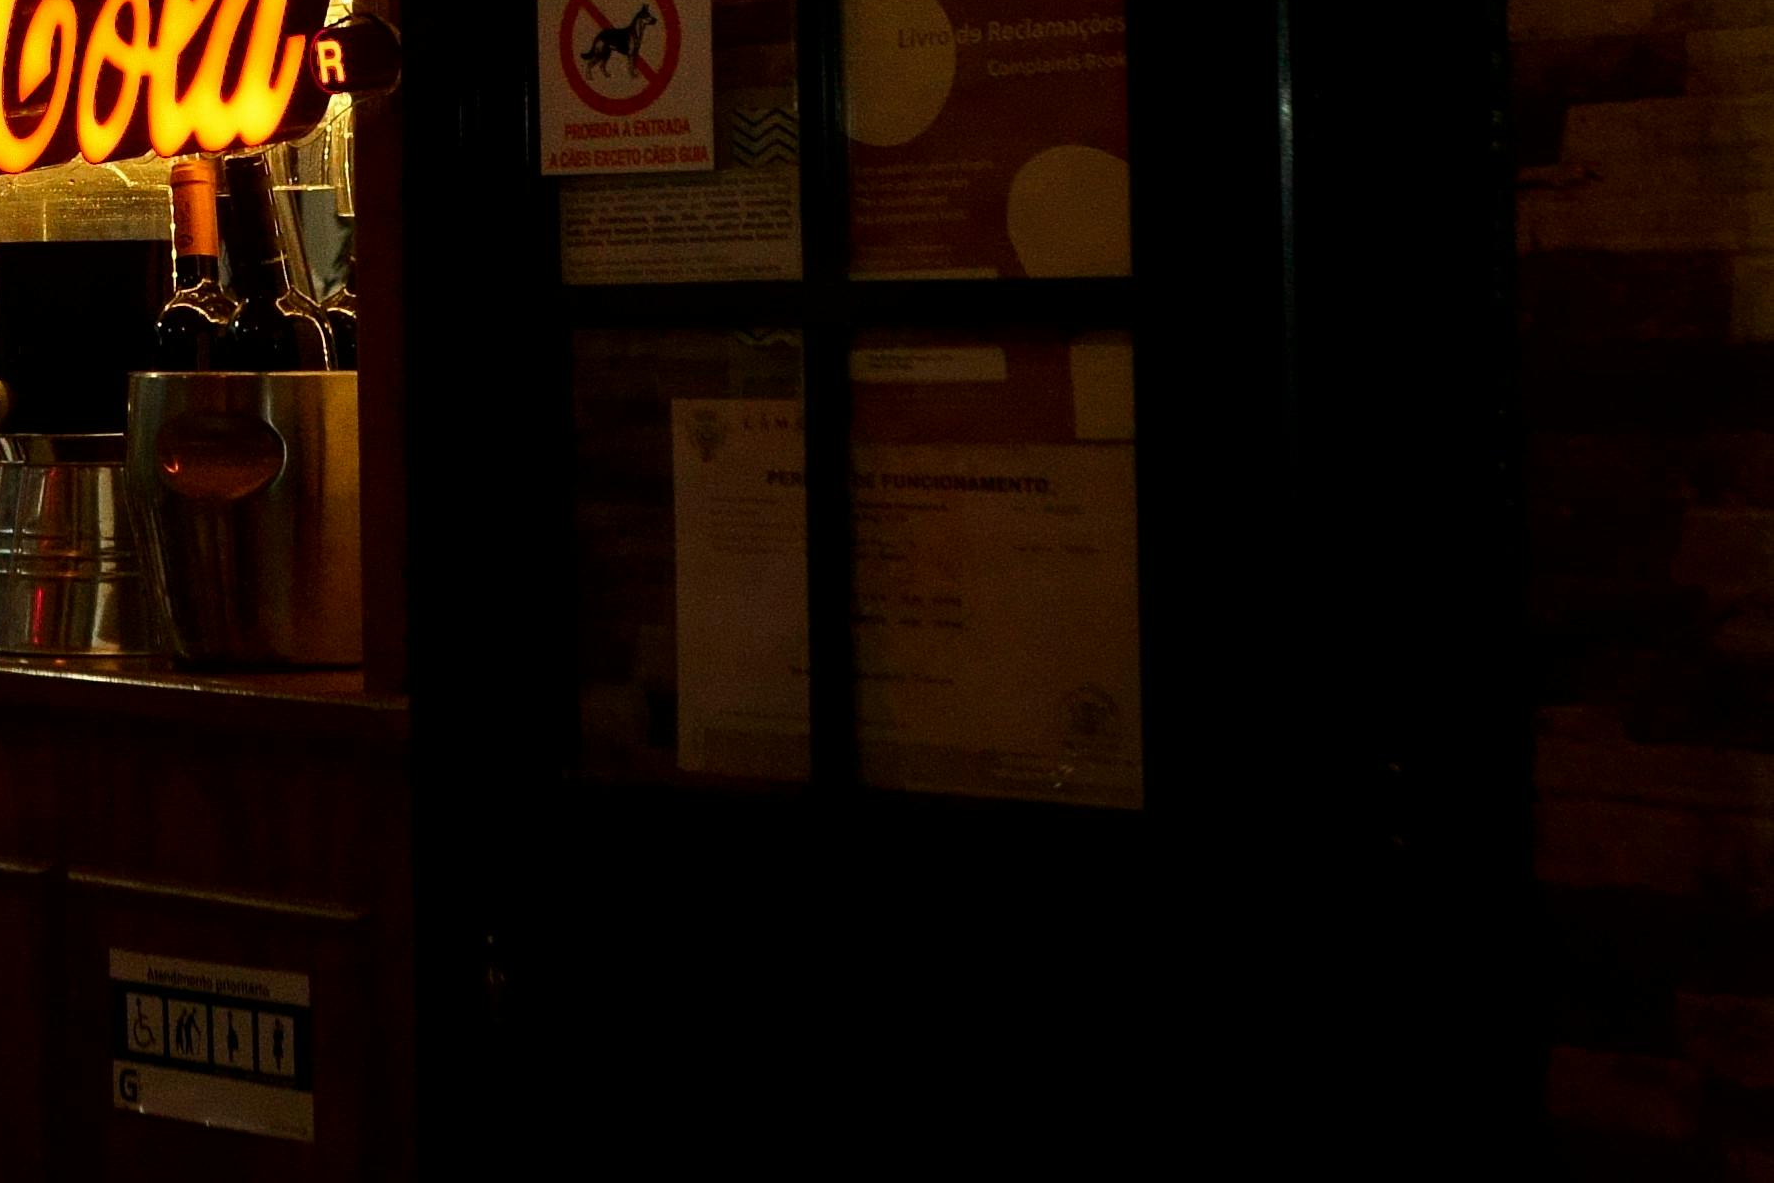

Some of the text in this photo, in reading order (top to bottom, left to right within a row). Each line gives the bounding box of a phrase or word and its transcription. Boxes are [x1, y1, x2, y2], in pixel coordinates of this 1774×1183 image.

[897, 14, 1126, 48] Livro de Reclamações
[988, 56, 1081, 77] Complaints
[622, 120, 631, 137] A
[634, 118, 691, 137] ENTRADA
[594, 149, 642, 166] EXCETO
[882, 474, 1049, 493] FUNCIONAMENTO
[120, 1070, 137, 1102] G
